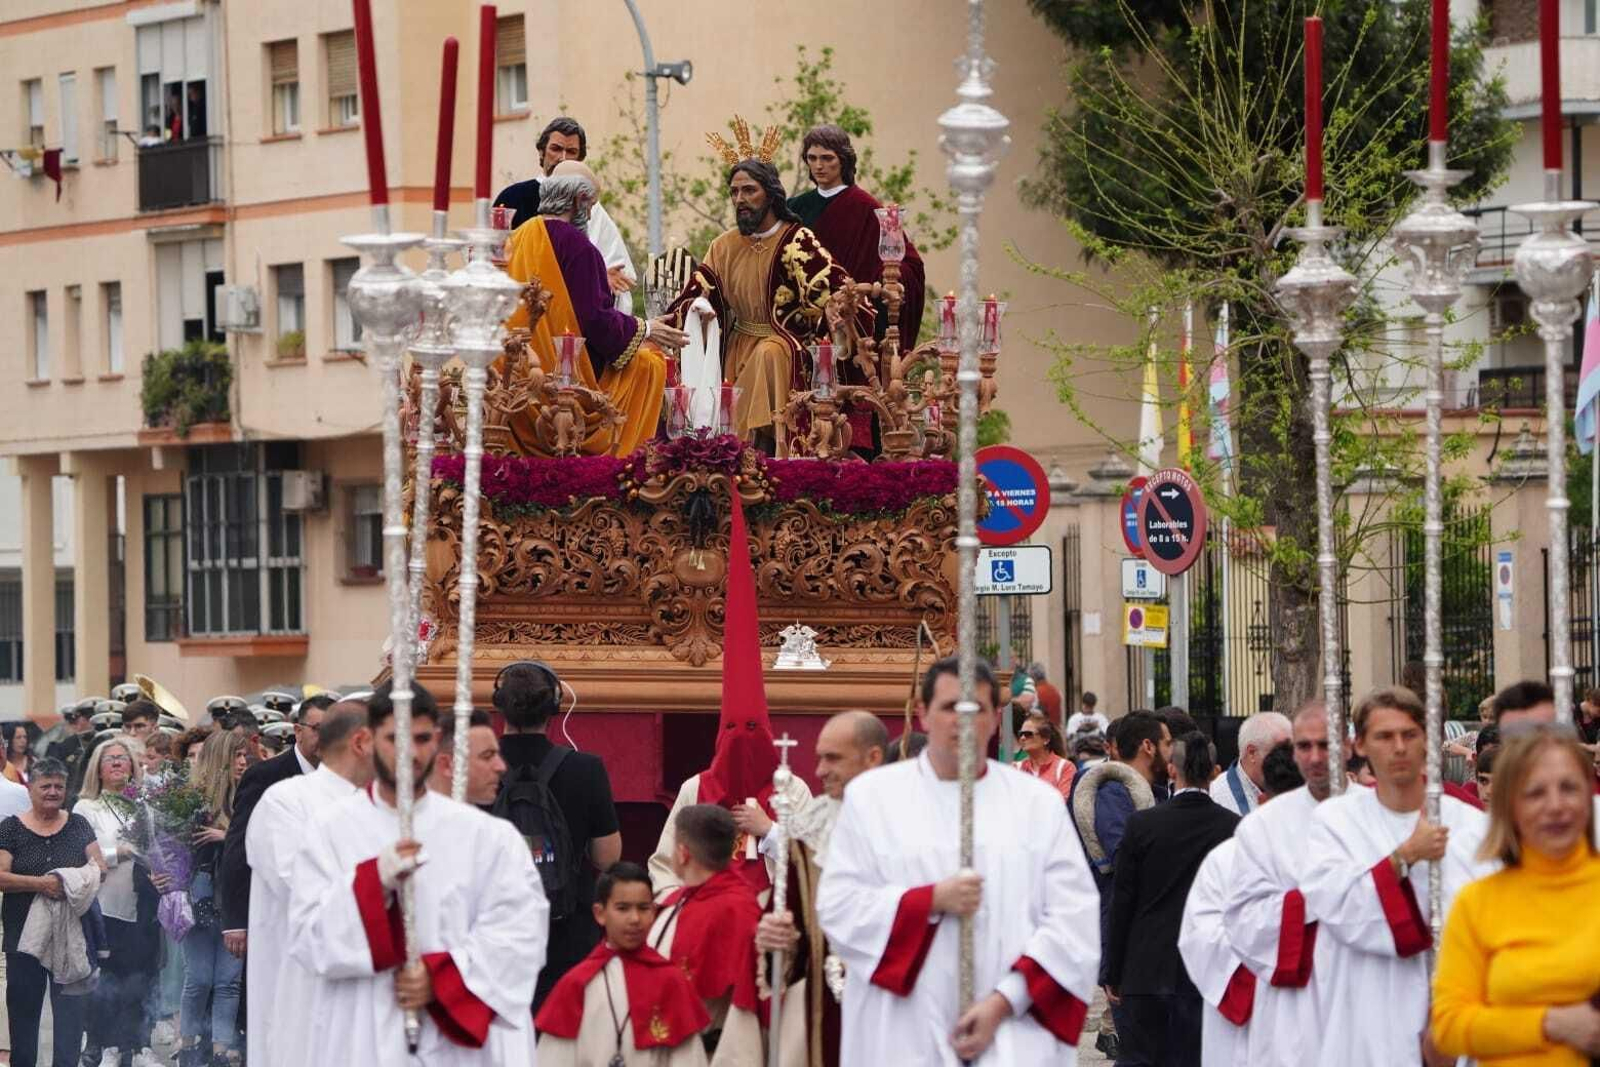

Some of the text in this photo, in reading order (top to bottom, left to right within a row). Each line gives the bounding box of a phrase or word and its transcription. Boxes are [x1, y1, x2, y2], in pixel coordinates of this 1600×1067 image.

[1145, 470, 1192, 492] EXCEPTO MOTOS
[1001, 489, 1036, 497] VIERNES
[1149, 519, 1188, 529] Laborables
[1149, 534, 1158, 543] de
[1165, 535, 1170, 543] a
[1171, 534, 1180, 543] 15
[988, 550, 1017, 558] Excepto
[1018, 583, 1044, 592] Tamayo
